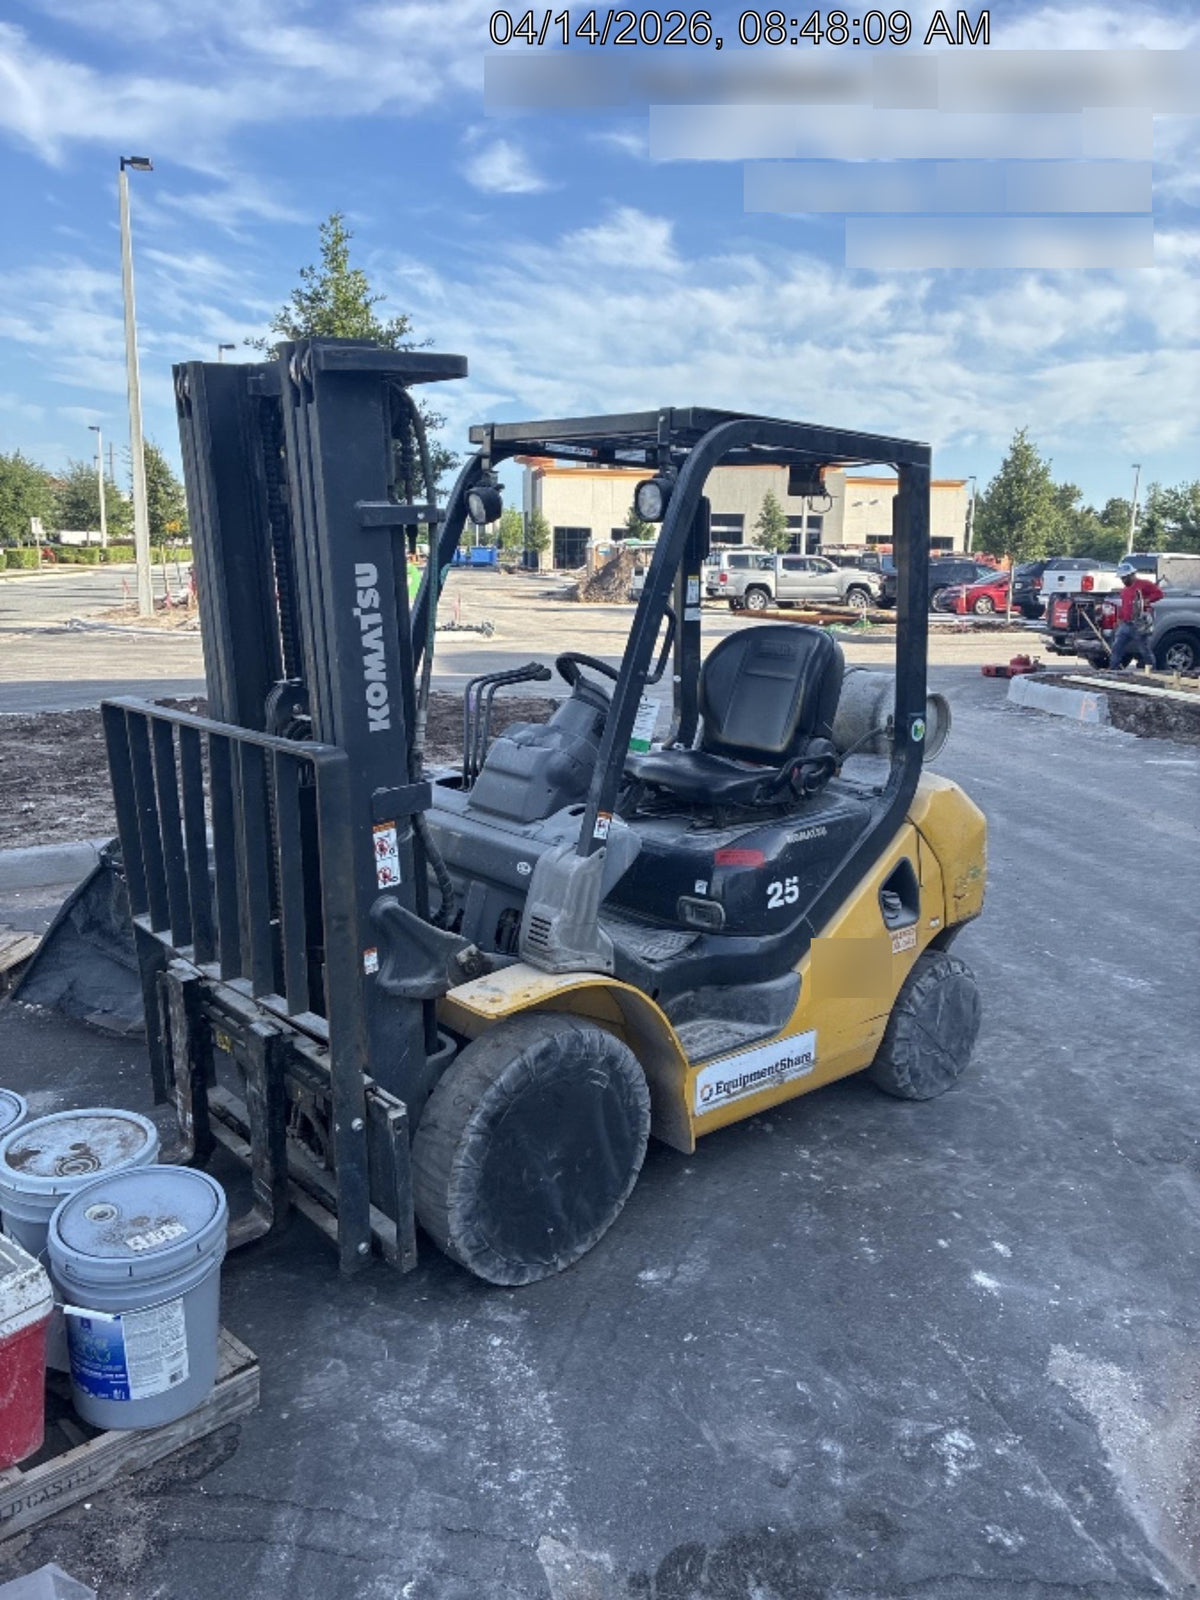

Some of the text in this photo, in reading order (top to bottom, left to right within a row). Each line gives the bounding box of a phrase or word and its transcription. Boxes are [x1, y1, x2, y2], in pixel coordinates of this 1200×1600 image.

[352, 562, 392, 733] KOMATSU
[766, 875, 800, 909] 25
[715, 1051, 812, 1095] EquipmentShare
